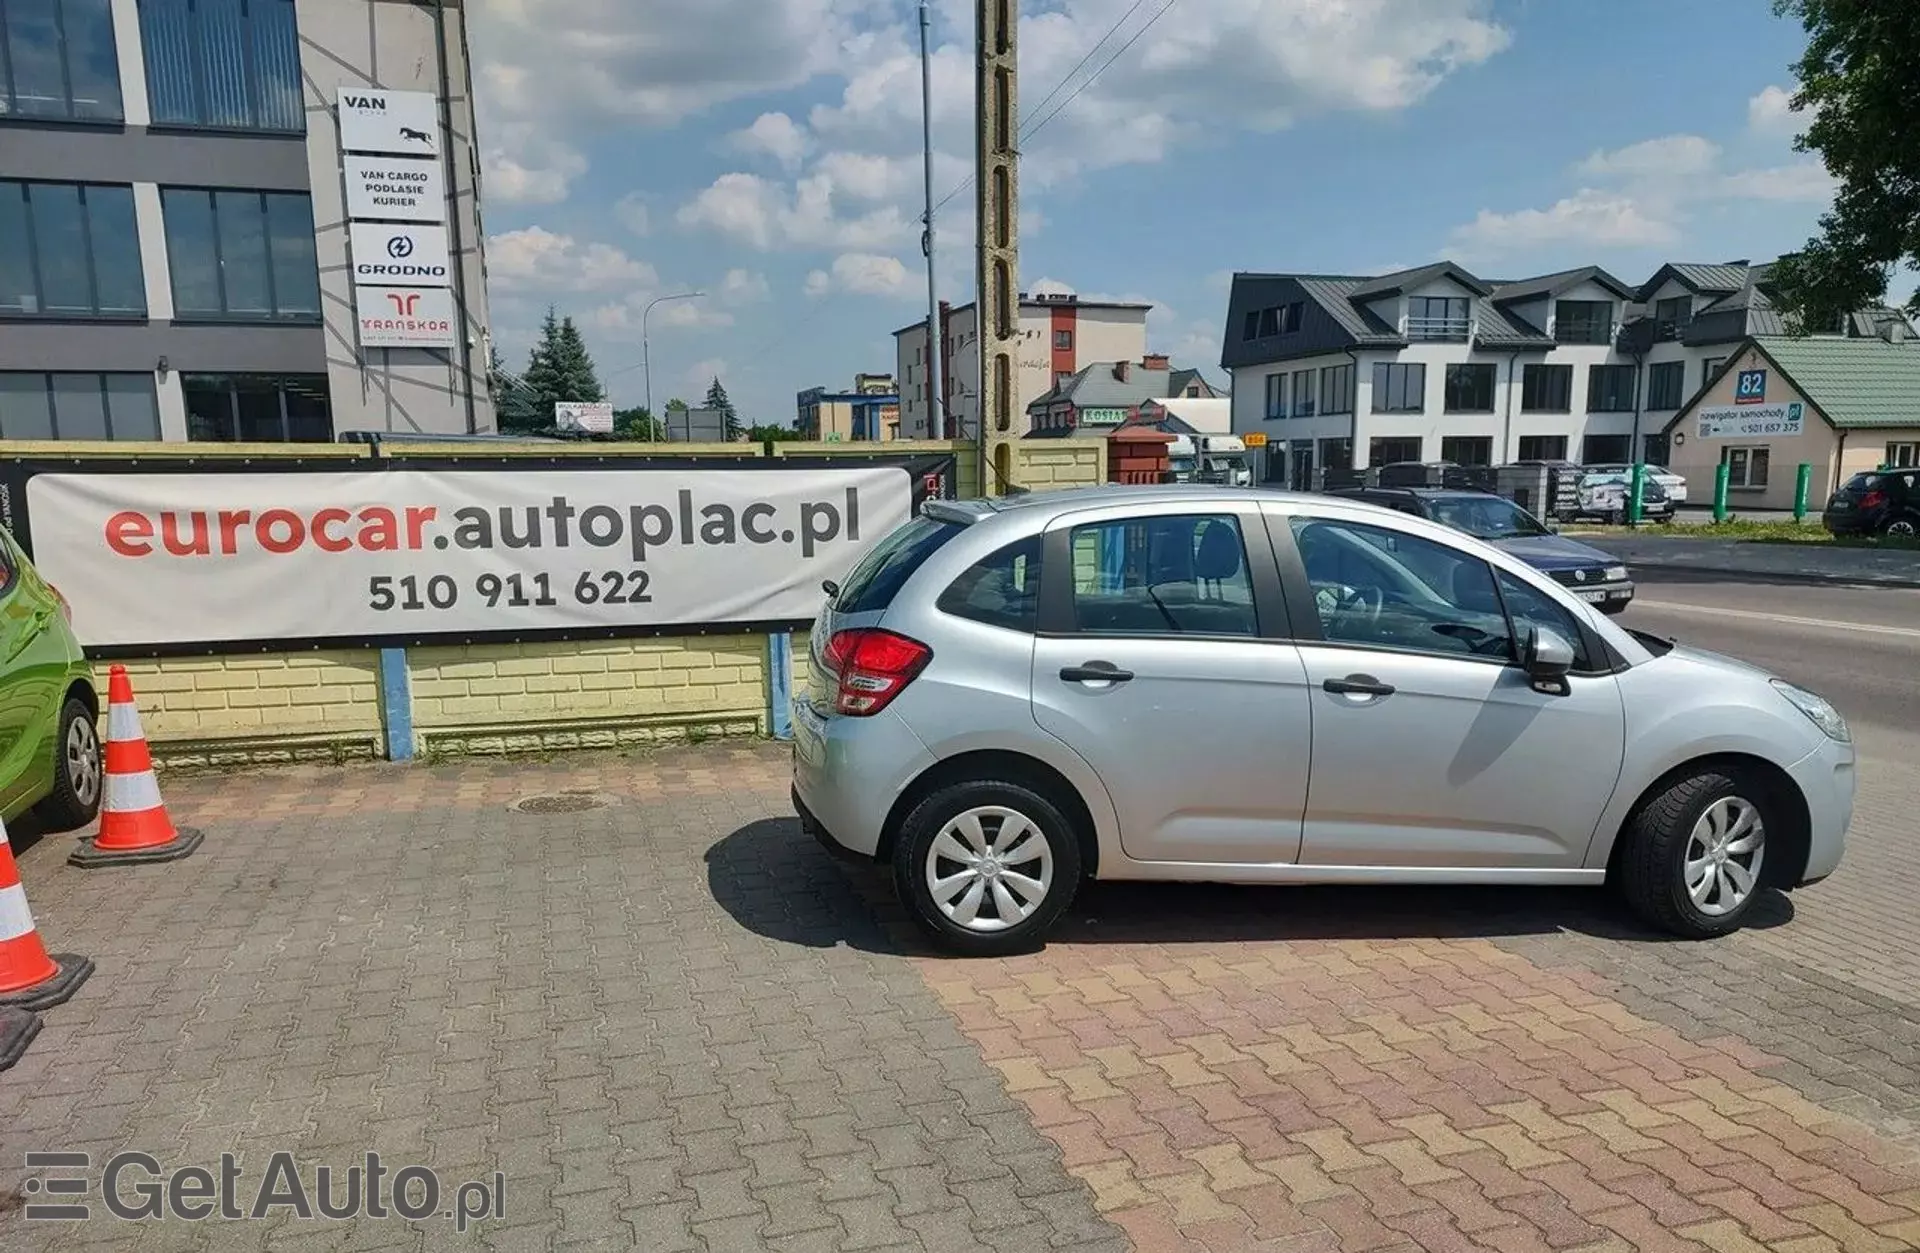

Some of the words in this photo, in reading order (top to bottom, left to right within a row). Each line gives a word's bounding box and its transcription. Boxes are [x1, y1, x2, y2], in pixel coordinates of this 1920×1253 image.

[344, 96, 386, 109] VAN
[360, 171, 384, 179] VAN
[388, 172, 428, 181] CARGO
[365, 184, 424, 194] PODLASIE
[373, 197, 416, 207] KURIER
[358, 264, 446, 276] GRODNO
[1741, 373, 1763, 394] 82
[1700, 410, 1738, 421] nawigator
[1748, 423, 1763, 433] 501
[1765, 423, 1780, 432] 657
[1783, 423, 1799, 432] 375
[104, 487, 859, 562] eurocar.autoplac.pl
[370, 575, 457, 610] 510
[476, 573, 556, 607] 911
[575, 571, 651, 604] 622
